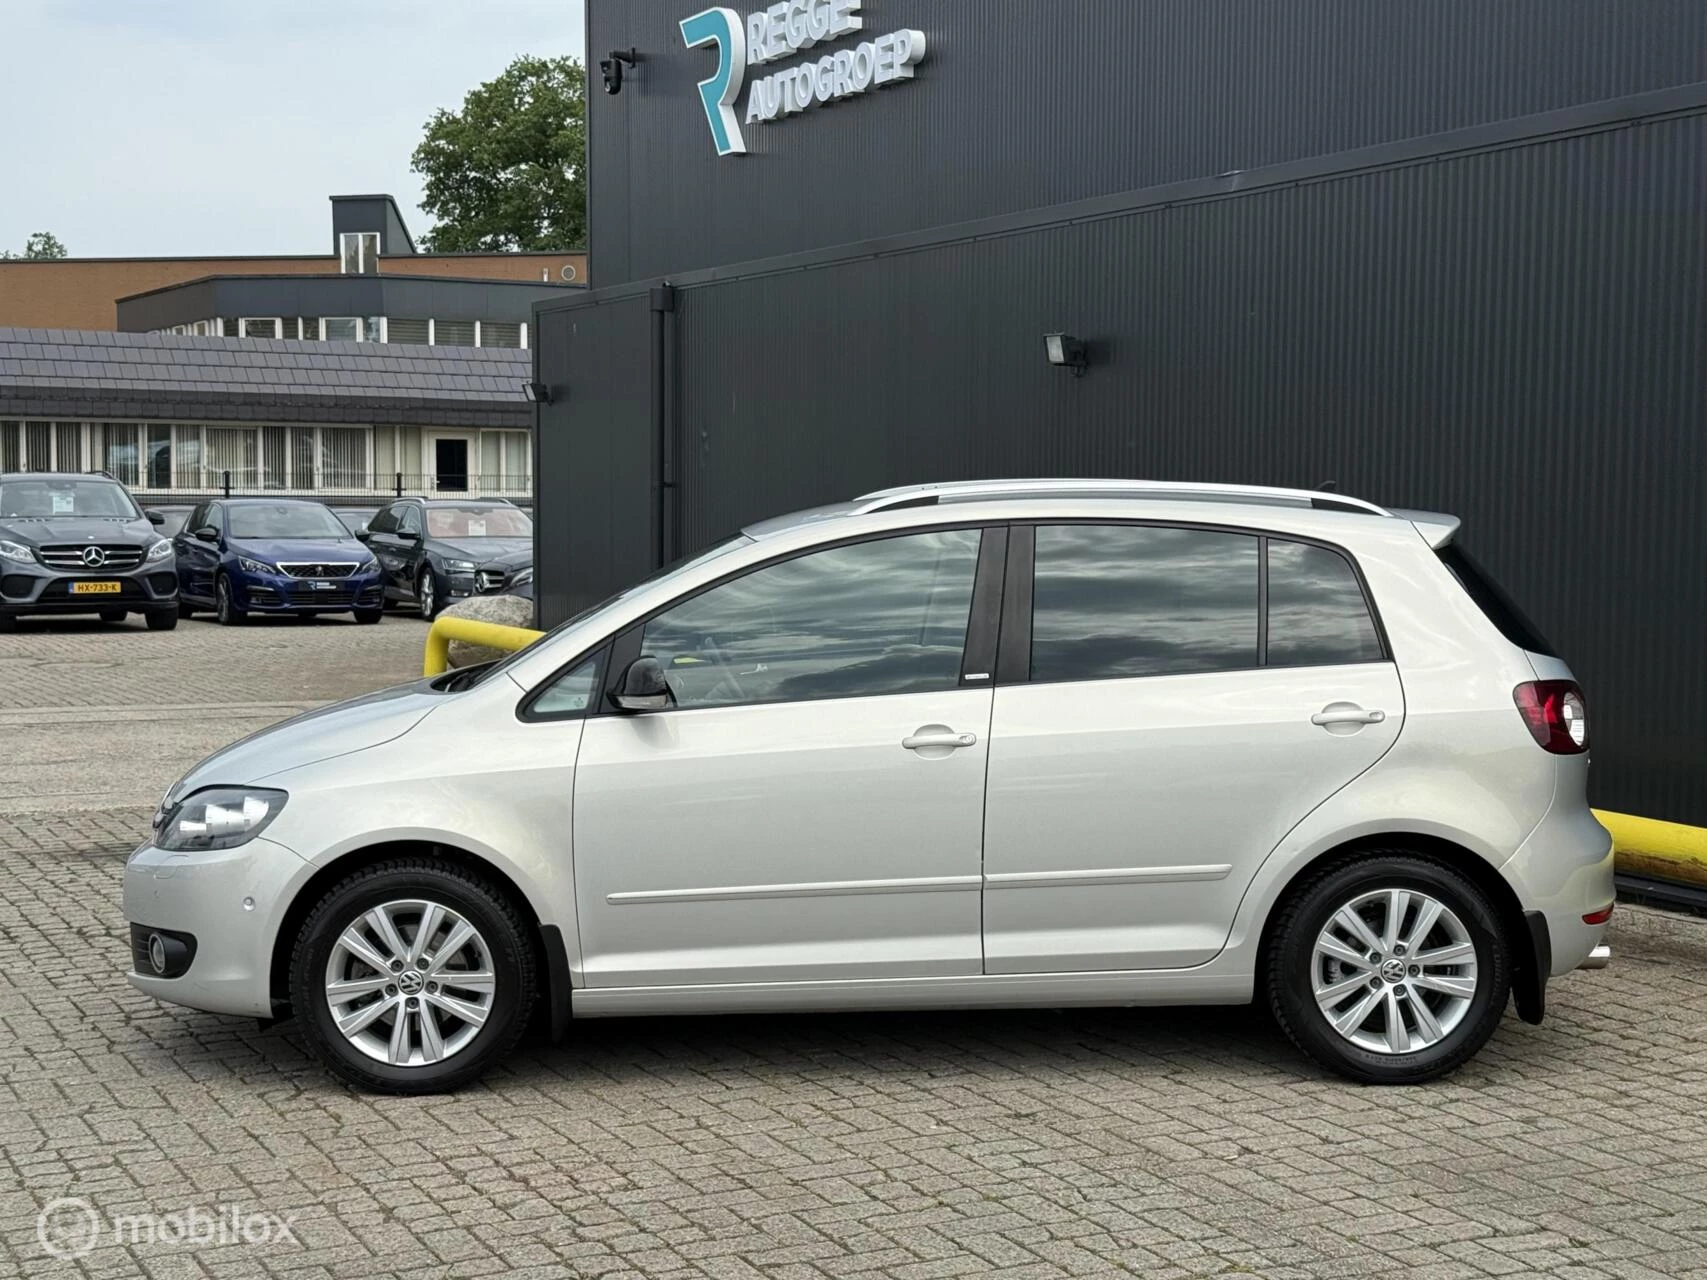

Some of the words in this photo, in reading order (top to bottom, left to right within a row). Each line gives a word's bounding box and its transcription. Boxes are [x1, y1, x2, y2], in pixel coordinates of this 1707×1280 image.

[747, 0, 862, 65] REGGE
[745, 28, 926, 124] AUTOGROEP
[78, 583, 117, 592] HX-733-K
